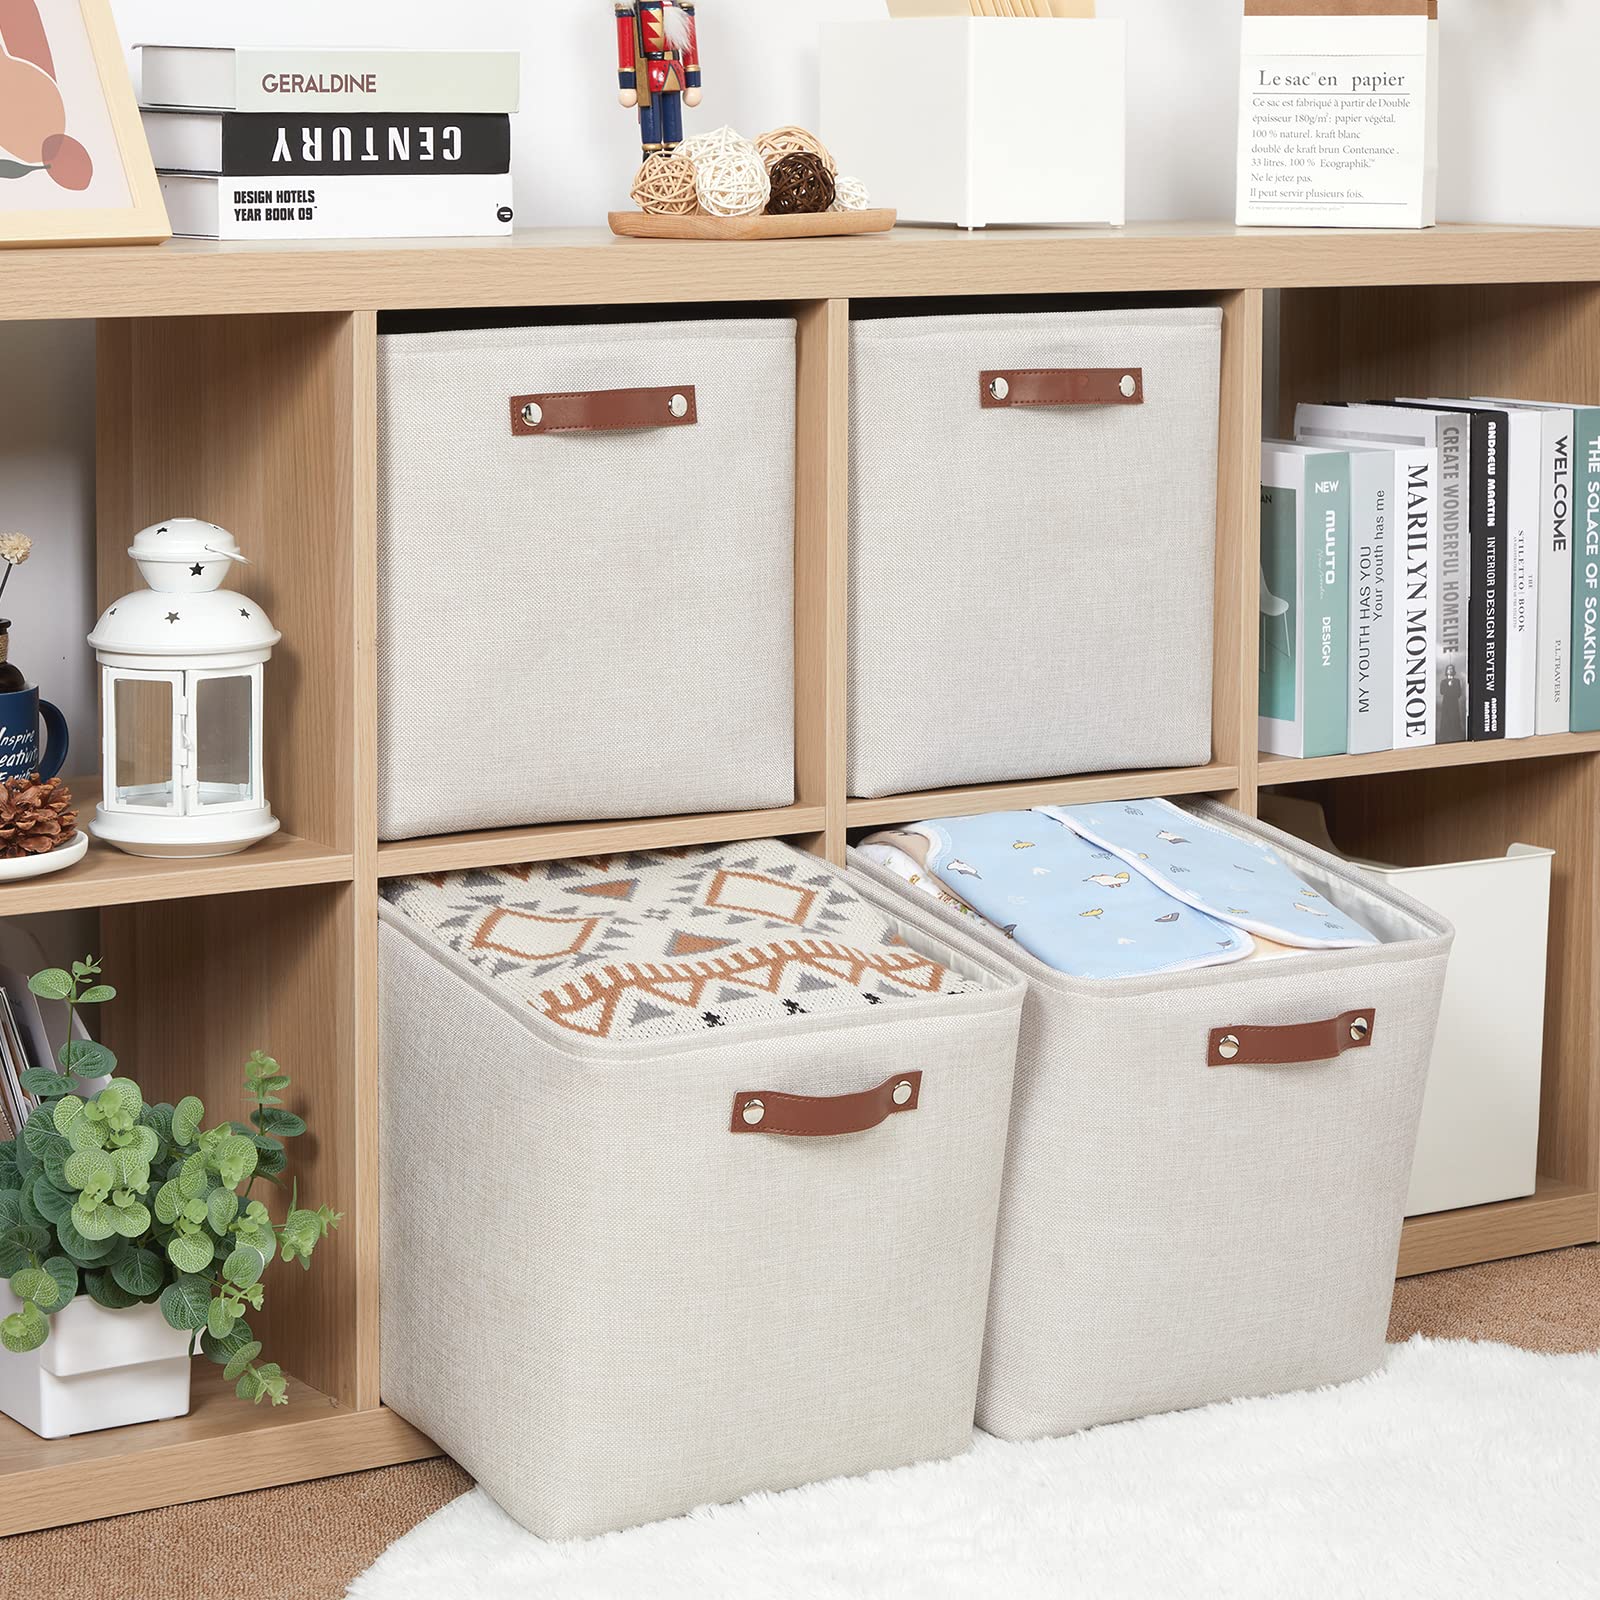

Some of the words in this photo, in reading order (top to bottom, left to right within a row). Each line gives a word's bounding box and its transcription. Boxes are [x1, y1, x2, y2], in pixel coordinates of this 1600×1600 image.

[262, 74, 377, 93] GERALDINE
[1258, 69, 1281, 86] Le
[1318, 75, 1338, 86] en
[1352, 71, 1405, 92] papier
[1252, 97, 1265, 107] Ce
[1282, 99, 1294, 107] est
[1296, 97, 1332, 110] fabriqué
[1333, 98, 1339, 108] à
[1340, 98, 1365, 110] partir
[1366, 98, 1378, 108] de
[1378, 98, 1411, 108] Double
[1252, 113, 1292, 125] épaisseur
[1335, 113, 1362, 125] papier
[271, 126, 462, 162] CENTURY
[1252, 129, 1267, 138] 100
[1268, 129, 1278, 138] %
[1315, 129, 1336, 138] kraft
[1337, 129, 1361, 139] blanc
[1283, 144, 1295, 154] de
[1296, 144, 1316, 154] kraft
[1318, 144, 1340, 154] brun
[1251, 158, 1262, 167] 33
[1290, 158, 1305, 167] 100
[1306, 158, 1316, 167] %
[1251, 172, 1264, 182] Ne
[1265, 172, 1274, 182] le
[1275, 173, 1295, 184] jetez
[234, 190, 273, 204] DESIGN
[276, 190, 315, 203] HOTELS
[1250, 187, 1256, 197] Il
[1258, 189, 1277, 200] peut
[1279, 188, 1304, 198] servir
[1305, 188, 1345, 200] plusieurs
[234, 208, 261, 221] YEAR
[265, 208, 294, 221] BOOK
[298, 207, 313, 221] 09
[1443, 427, 1460, 480] CREATE
[1487, 421, 1497, 476] ANDREW
[1588, 435, 1600, 473] THE
[1315, 480, 1339, 494] NEW
[1376, 490, 1385, 511] me
[1487, 478, 1496, 527] MARTIN
[1553, 435, 1568, 552] WELCOME
[1374, 515, 1385, 540] has
[1406, 463, 1429, 600] MARILYN
[1443, 483, 1460, 577] WONDERFUL
[1586, 481, 1600, 556] SOLACE
[1360, 545, 1372, 582] YOU
[1374, 544, 1385, 584] youth
[1486, 536, 1496, 587] INTERIOR
[1585, 563, 1598, 589] OF
[1359, 586, 1371, 620] HAS
[1373, 588, 1384, 621] Your
[1443, 580, 1460, 654] HOMELIFE
[1486, 589, 1495, 639] DESIGN
[1322, 617, 1331, 667] DESIGN
[1358, 625, 1370, 682] YOUTH
[1583, 597, 1598, 686] SOAKING
[1405, 608, 1428, 738] MONROE
[1358, 687, 1370, 713] MY
